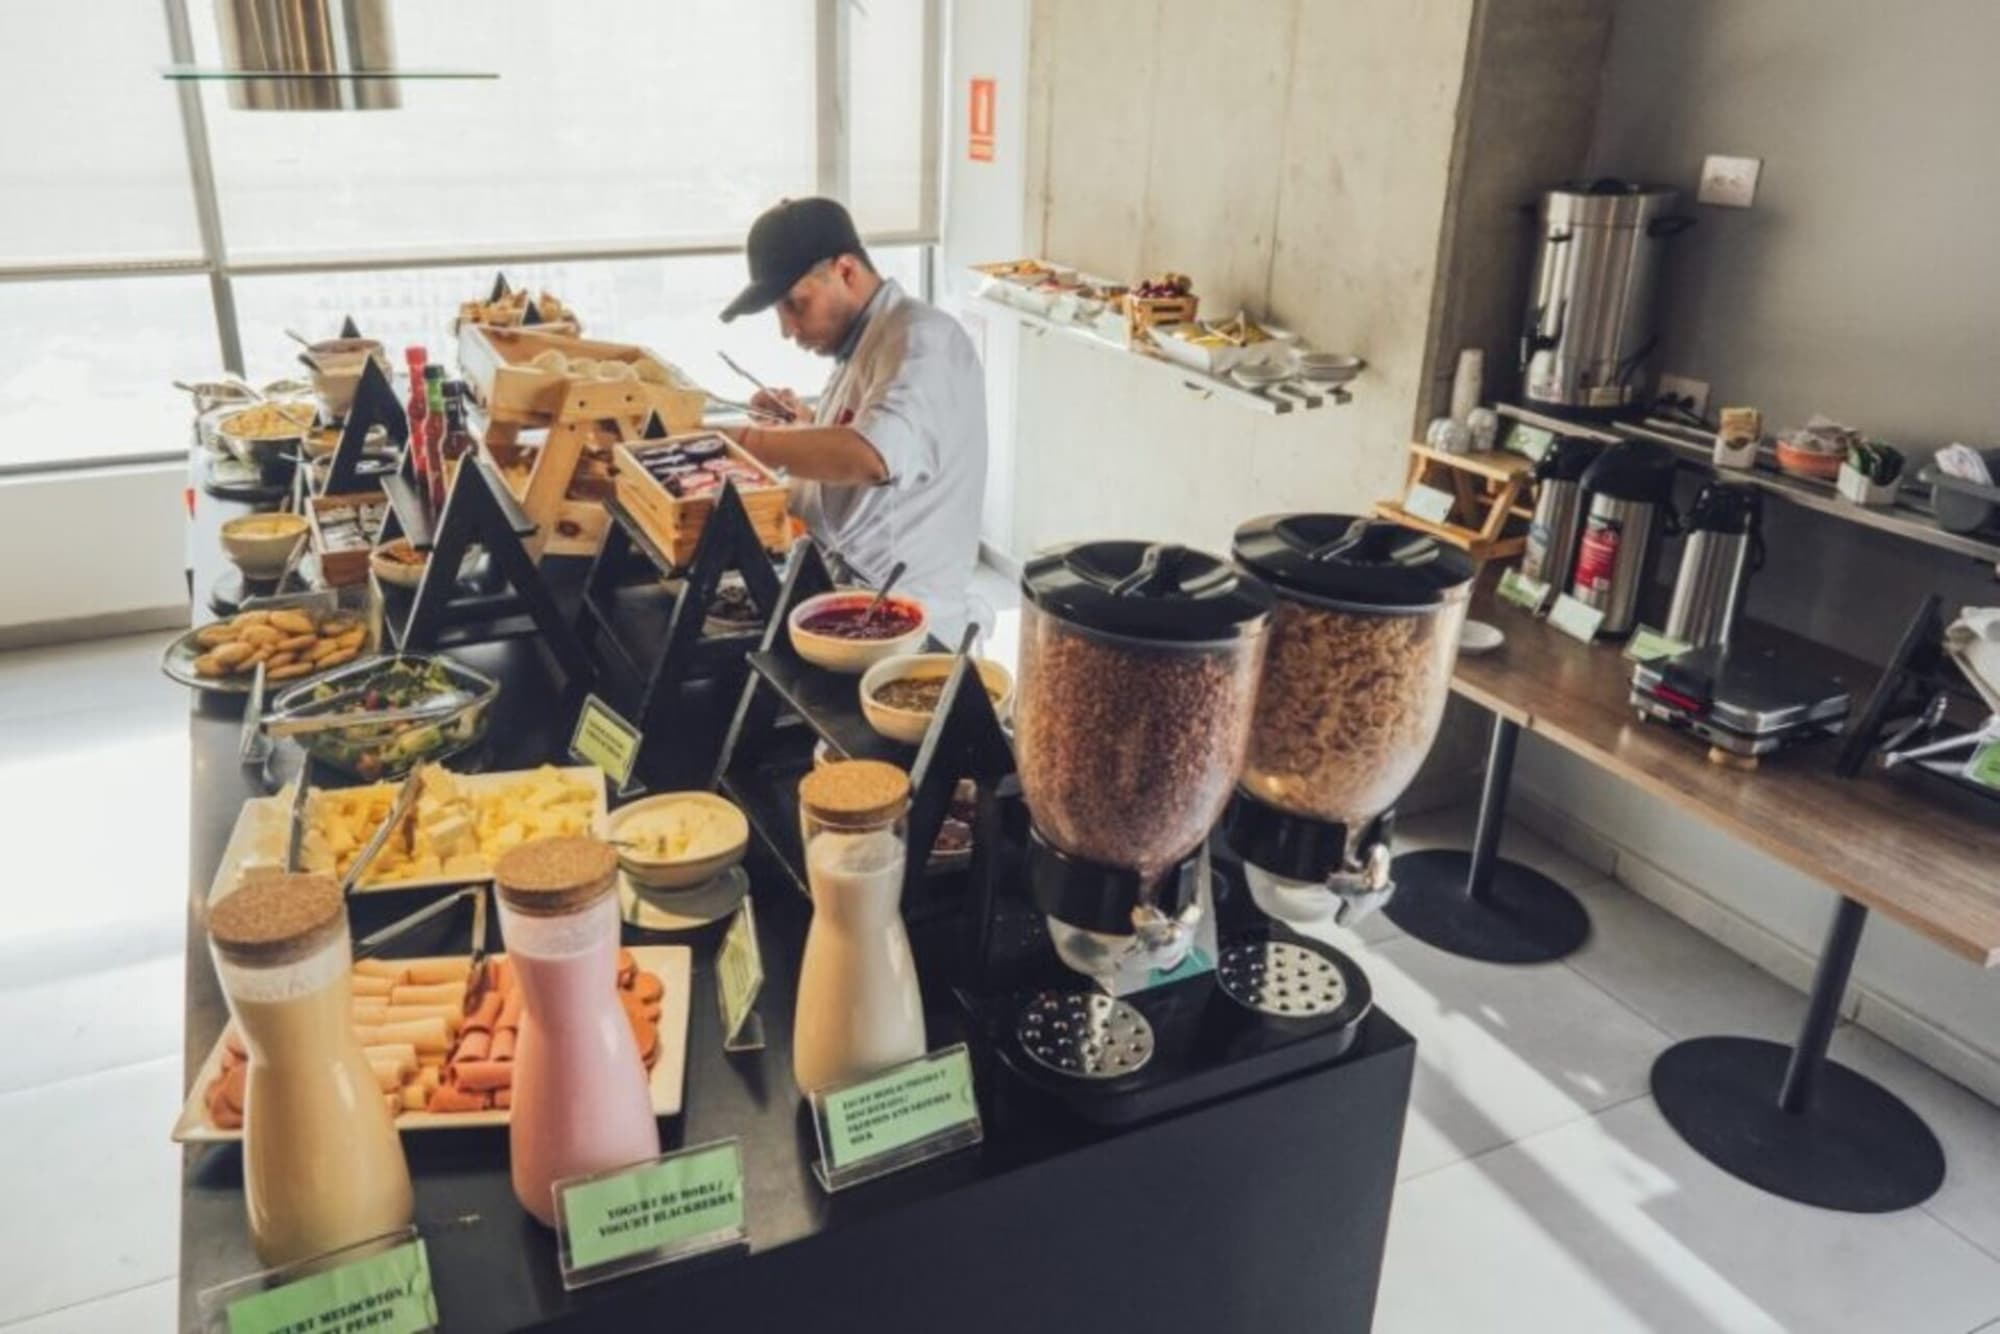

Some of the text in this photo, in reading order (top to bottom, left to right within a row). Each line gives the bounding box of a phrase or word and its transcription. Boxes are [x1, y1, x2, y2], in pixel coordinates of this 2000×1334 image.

[599, 1191, 734, 1236] YOGURT BLACKBERRY
[608, 1198, 657, 1219] YOGURT
[661, 1192, 677, 1205] DE
